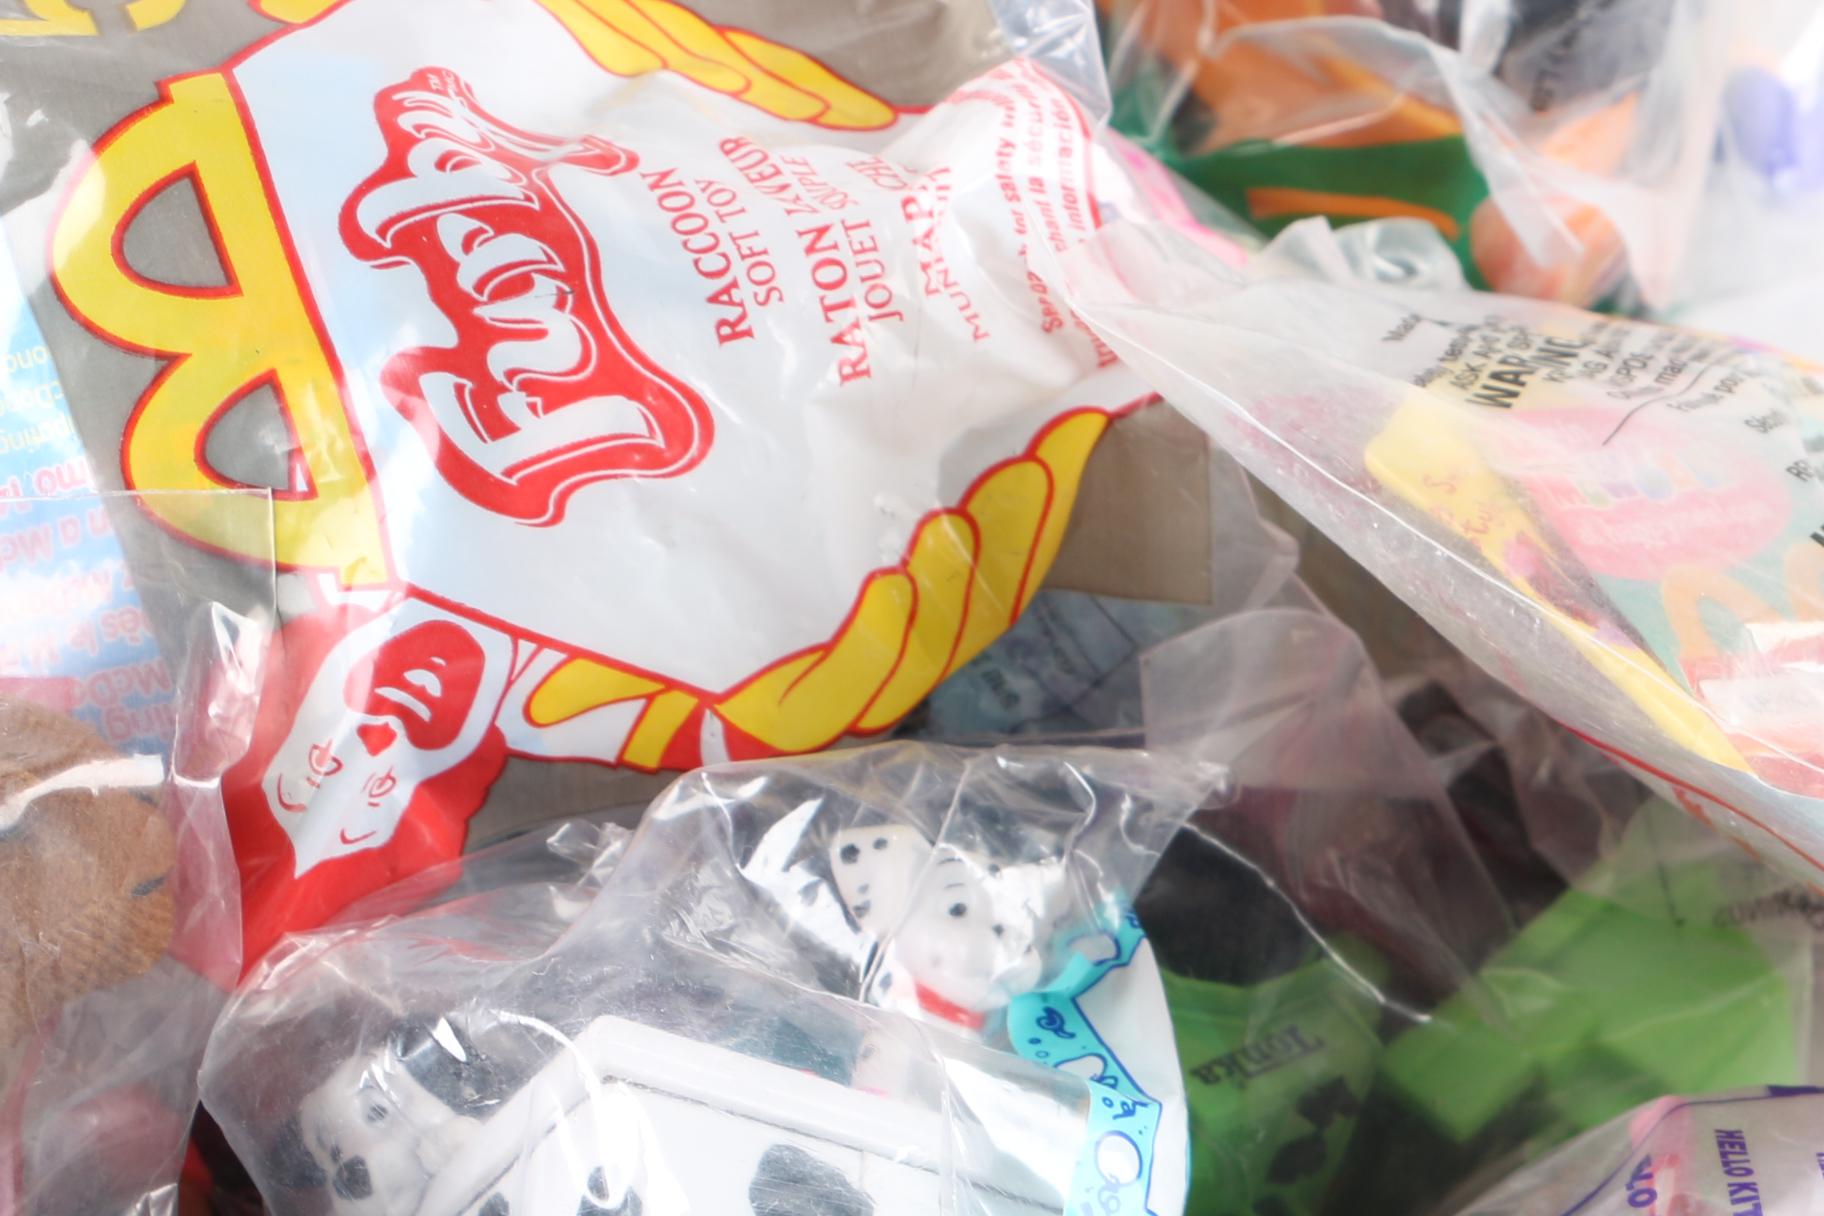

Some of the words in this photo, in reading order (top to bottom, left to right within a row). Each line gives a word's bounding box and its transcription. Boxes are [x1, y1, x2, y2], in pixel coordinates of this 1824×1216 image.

[694, 175, 736, 228] TOY
[352, 88, 664, 487] Furby
[641, 166, 756, 347] RACCOON
[726, 215, 785, 309] SOFT
[796, 222, 872, 387] RATON
[840, 218, 904, 323] JOUET
[1713, 1128, 1755, 1178] HELLO
